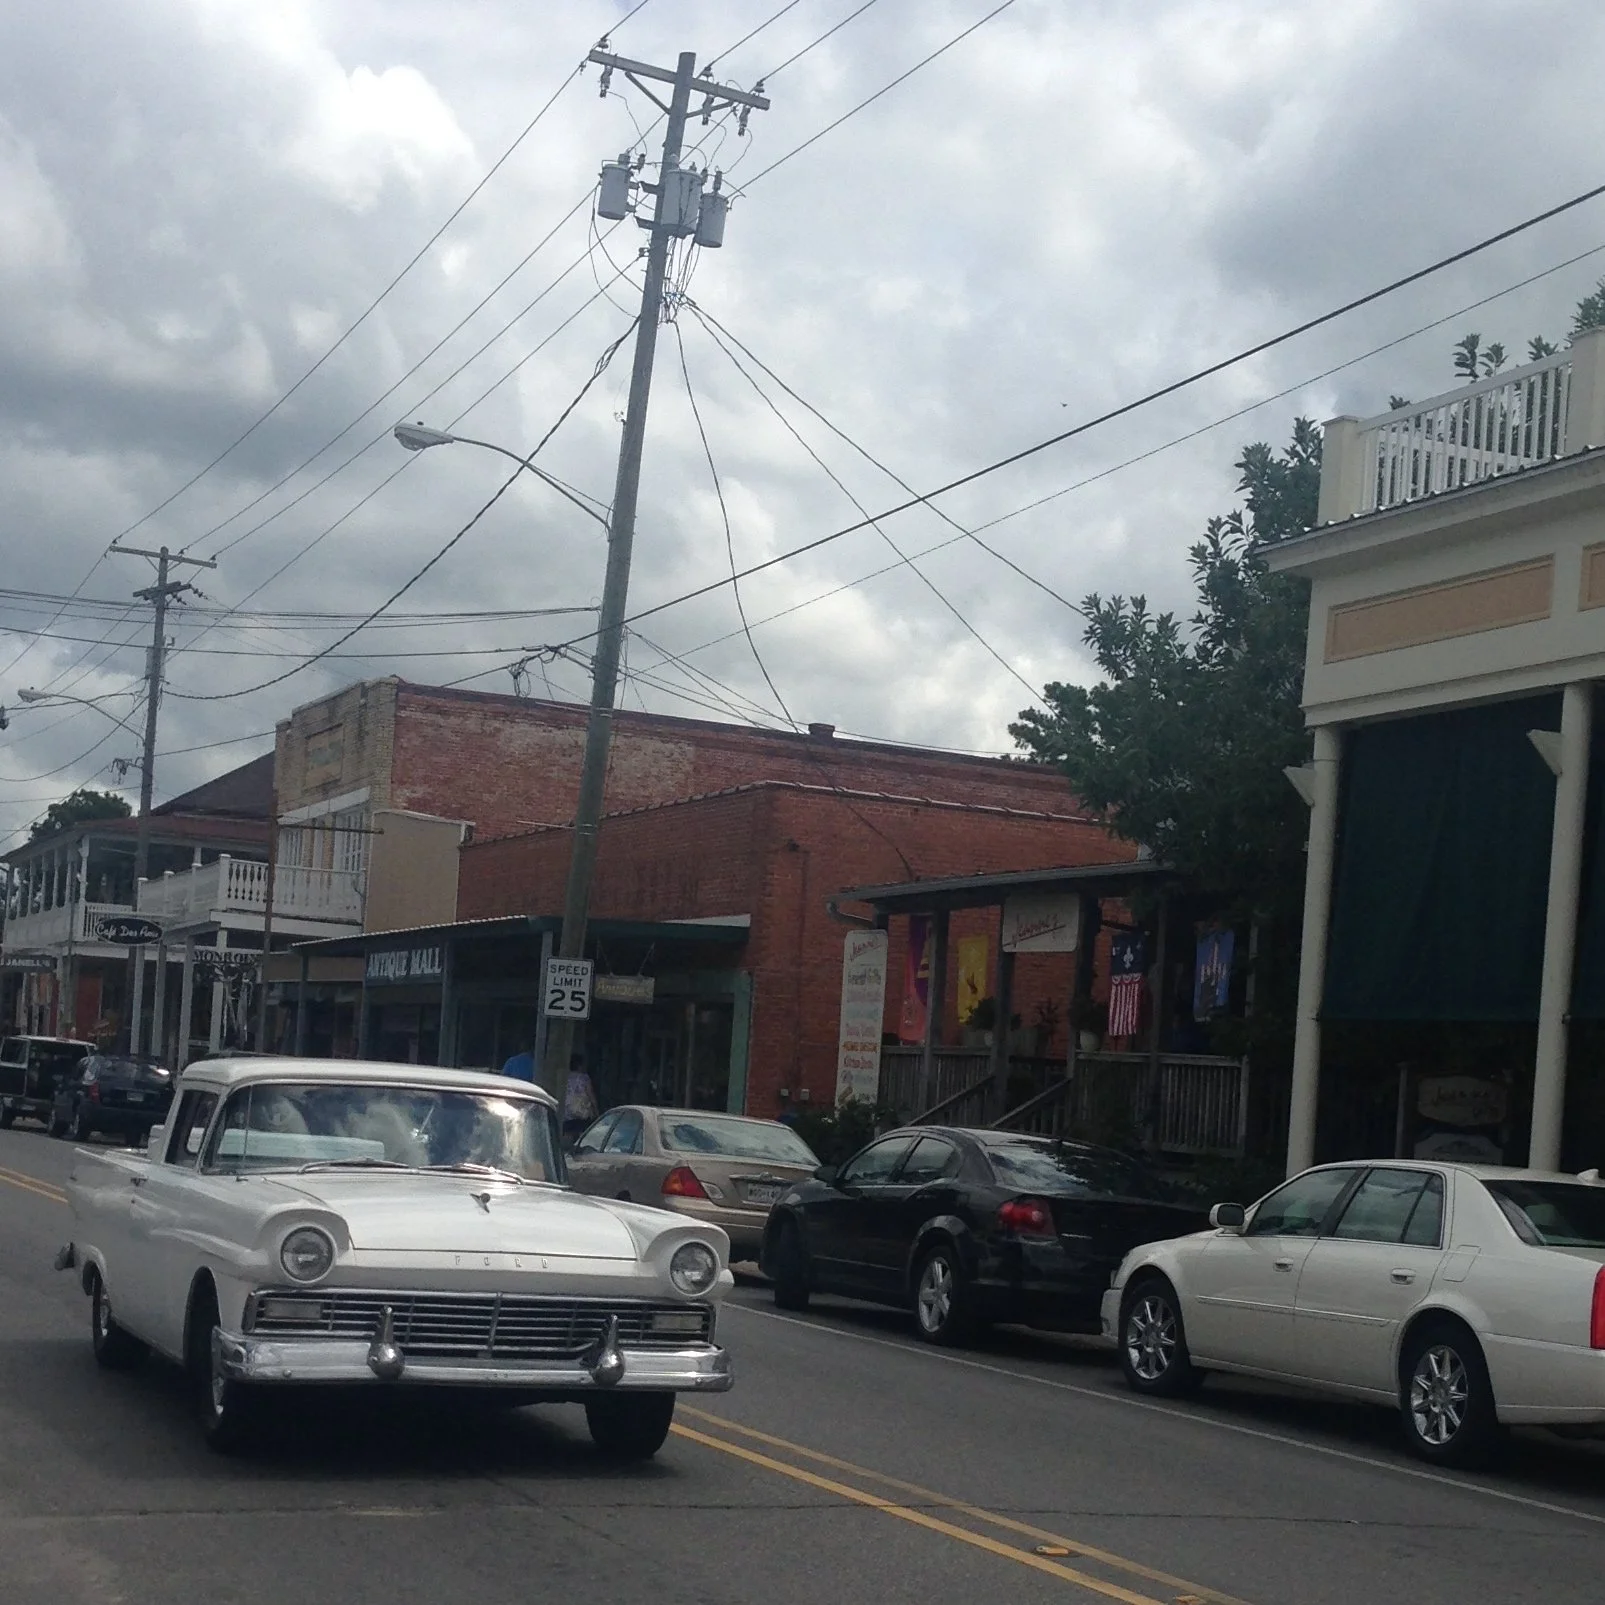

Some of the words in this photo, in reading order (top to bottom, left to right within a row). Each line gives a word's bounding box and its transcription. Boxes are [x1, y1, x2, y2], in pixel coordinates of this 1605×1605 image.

[119, 925, 138, 937] Des
[366, 951, 409, 981] ANTIQUE
[410, 947, 442, 975] MALL
[550, 964, 589, 976] SPEED
[553, 977, 583, 988] LIMIT
[548, 988, 586, 1012] 25
[455, 1255, 549, 1269] FORD
